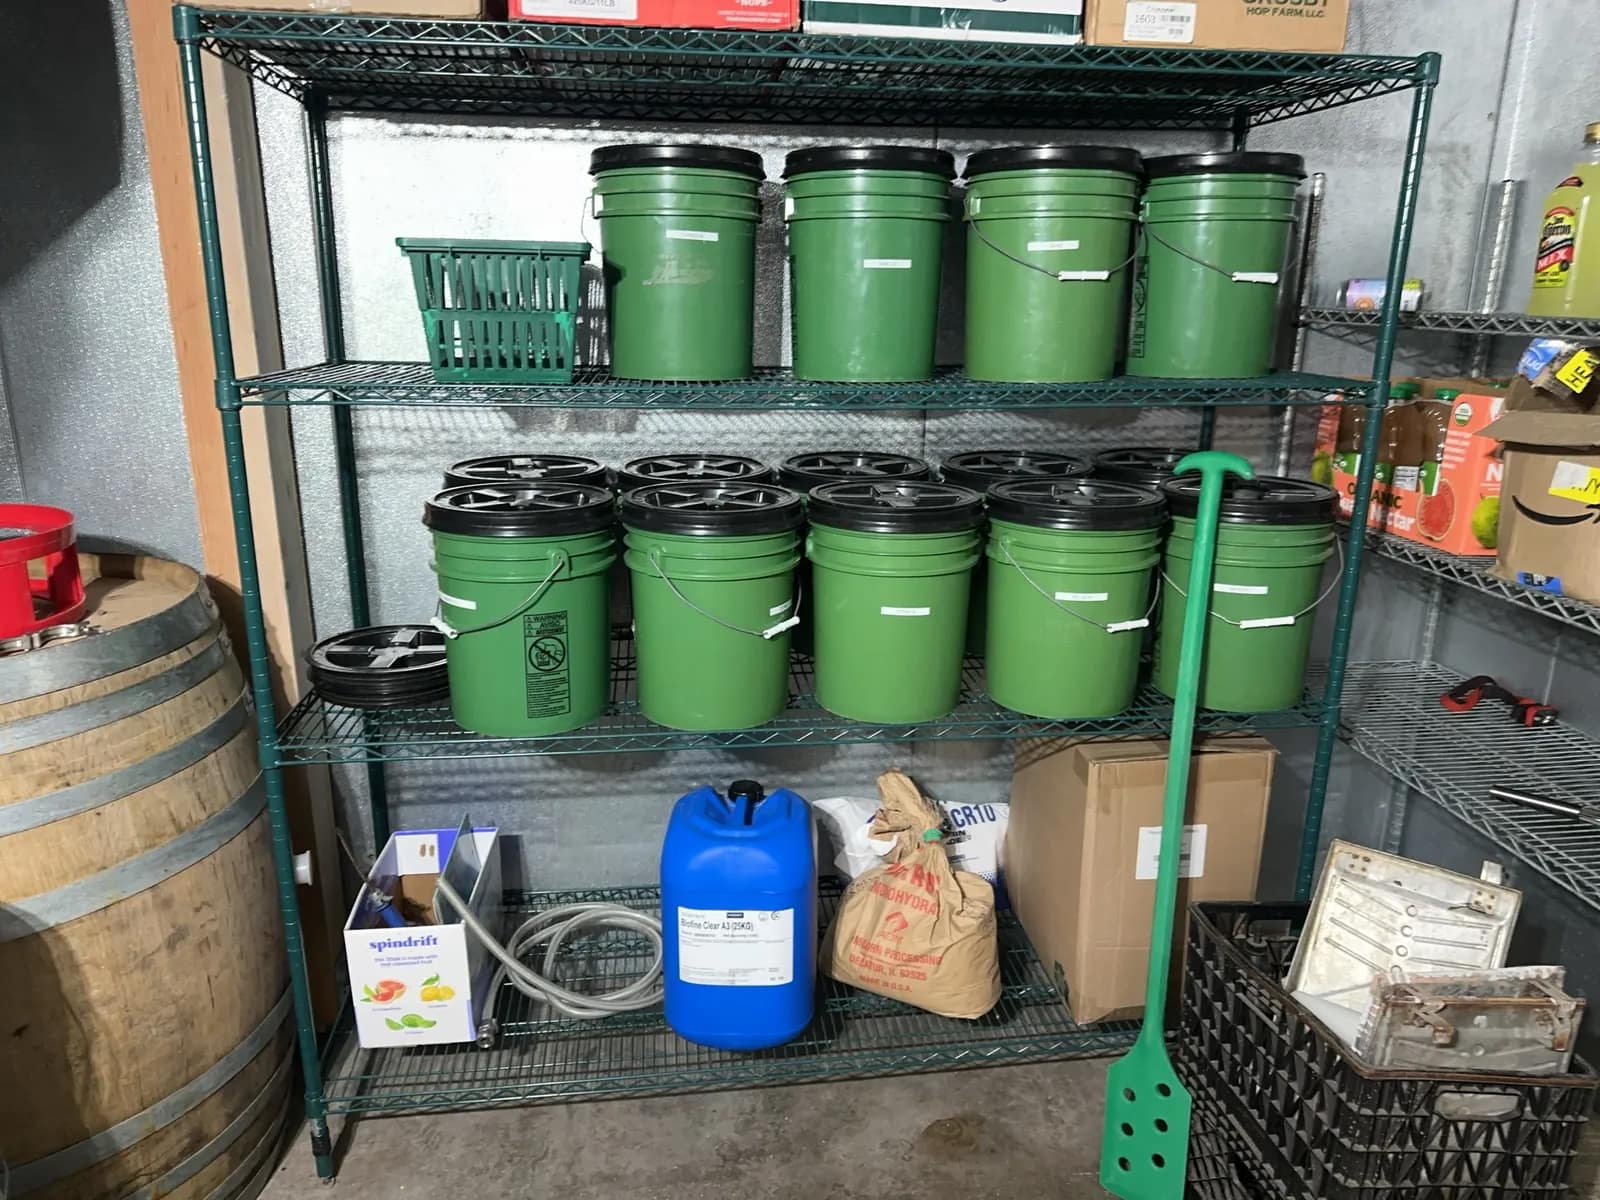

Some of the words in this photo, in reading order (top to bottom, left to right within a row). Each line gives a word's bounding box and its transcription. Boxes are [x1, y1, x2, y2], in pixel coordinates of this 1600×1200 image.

[1246, 7, 1271, 16] HOP
[1271, 8, 1304, 17] FARM
[369, 935, 438, 952] spindrift
